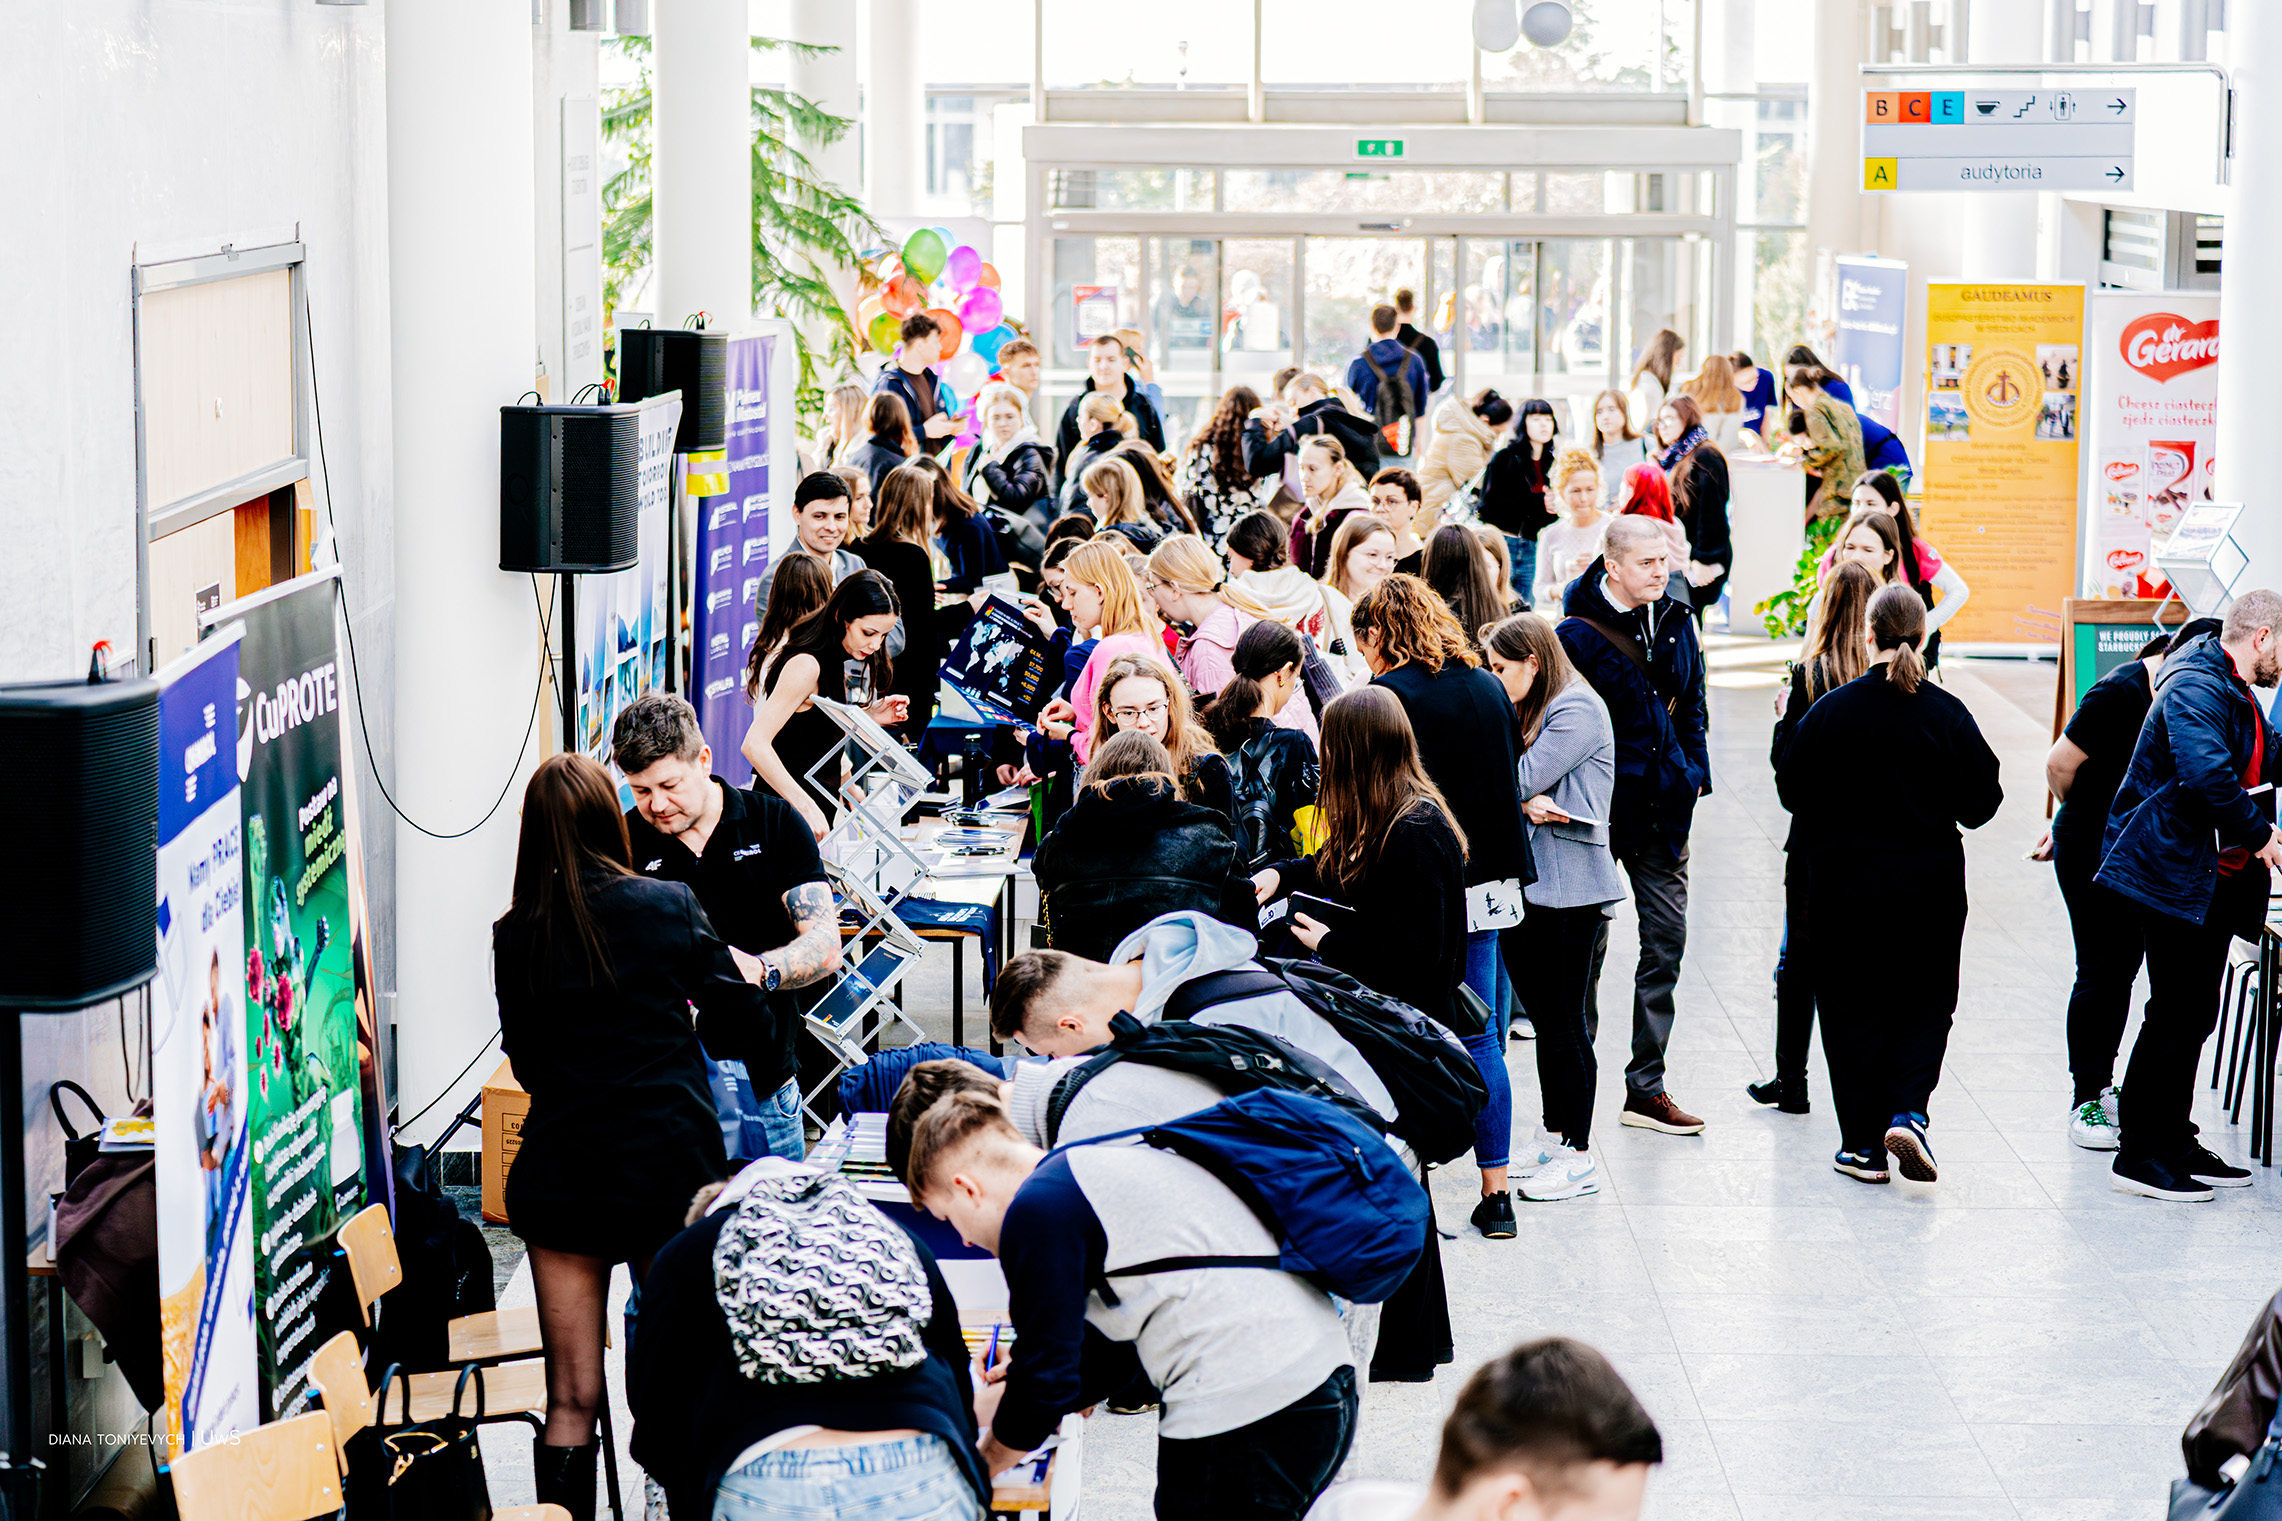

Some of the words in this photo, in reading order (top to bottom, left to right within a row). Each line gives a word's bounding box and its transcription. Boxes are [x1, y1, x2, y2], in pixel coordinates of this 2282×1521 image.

[1875, 99, 1888, 117] B
[1908, 99, 1922, 117] C
[1942, 98, 1954, 116] E
[1873, 165, 1889, 183] A
[1960, 163, 2043, 183] audytoria
[1961, 289, 2053, 302] GAUDEAMUS
[2163, 323, 2187, 343] dr
[2118, 394, 2160, 410] Chcesz
[2164, 396, 2217, 411] ciastecz
[2122, 412, 2154, 430] zjedz
[2099, 631, 2112, 641] WE
[2113, 630, 2148, 642] PROUDLY
[256, 662, 337, 744] CuPROTE
